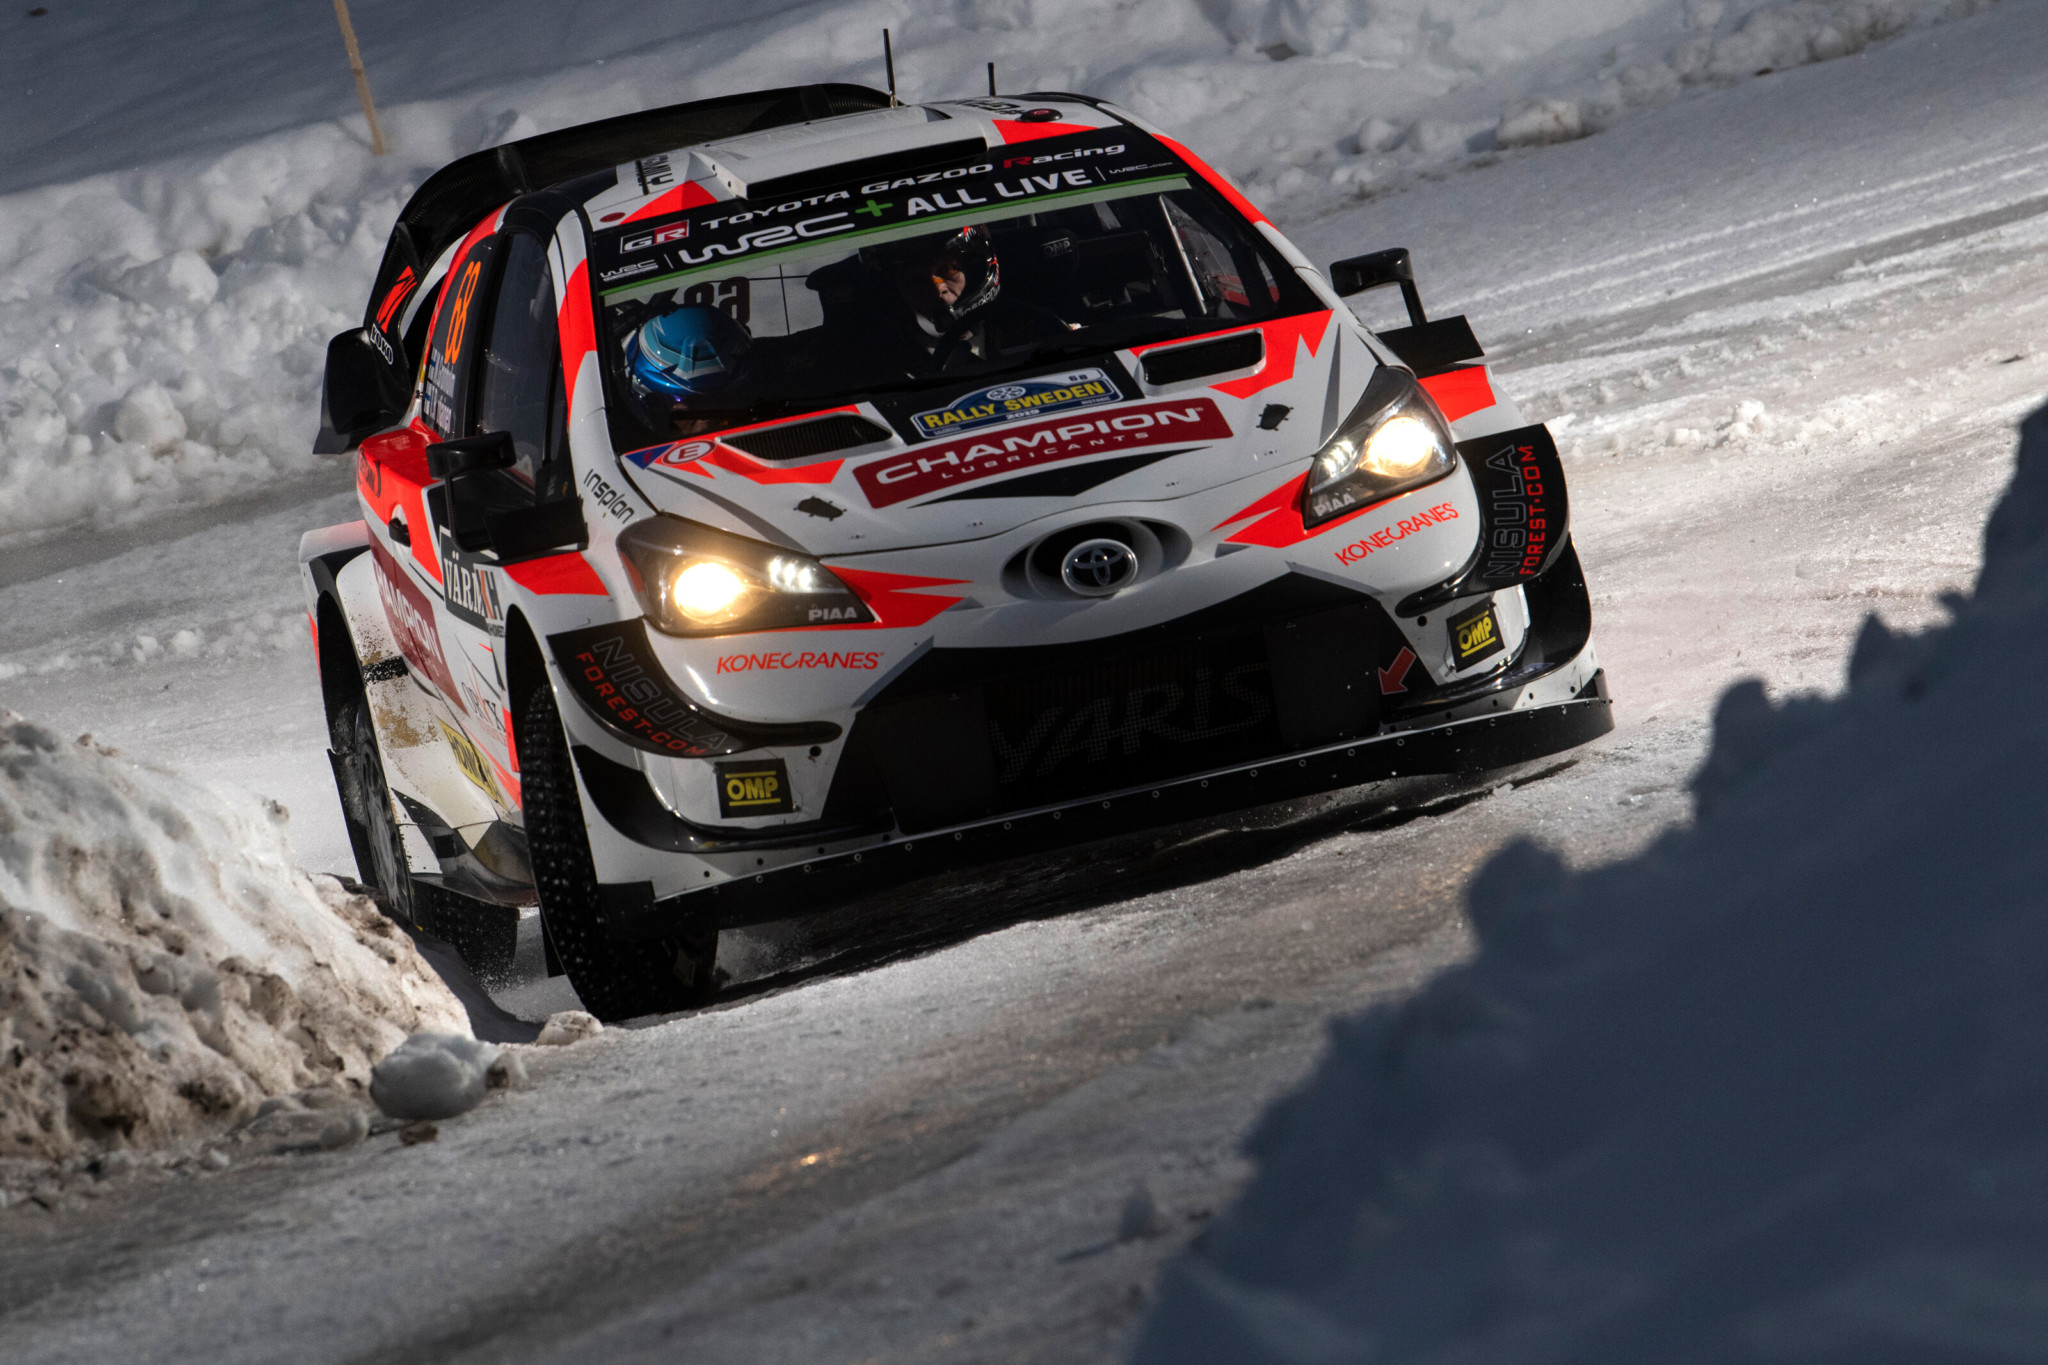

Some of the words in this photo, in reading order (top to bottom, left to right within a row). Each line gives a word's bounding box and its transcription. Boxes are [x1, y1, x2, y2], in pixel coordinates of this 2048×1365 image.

[701, 191, 850, 230] TOYOTA
[860, 163, 994, 196] GAZOO
[1003, 143, 1126, 169] Racing
[907, 189, 988, 217] ALL
[994, 168, 1093, 199] LIVE
[623, 226, 686, 251] GR
[599, 259, 657, 278] WRC
[444, 260, 482, 365] 68
[923, 403, 996, 429] RALLY
[1004, 381, 1106, 411] SWEDEN
[1005, 408, 1041, 420] 2019
[677, 444, 701, 460] E
[875, 407, 1200, 486] CHAMPION
[940, 431, 1150, 480] LUBRICANTS
[1313, 492, 1356, 518] PIAA
[1483, 444, 1527, 579] NISULA
[1333, 503, 1459, 567] KONECRANES
[372, 559, 442, 664] HAMPION
[808, 606, 858, 622] PIAA
[1458, 614, 1495, 652] OMP
[716, 652, 879, 675] KONECRANES
[591, 636, 730, 751] NISULA
[727, 776, 779, 801] OMP
